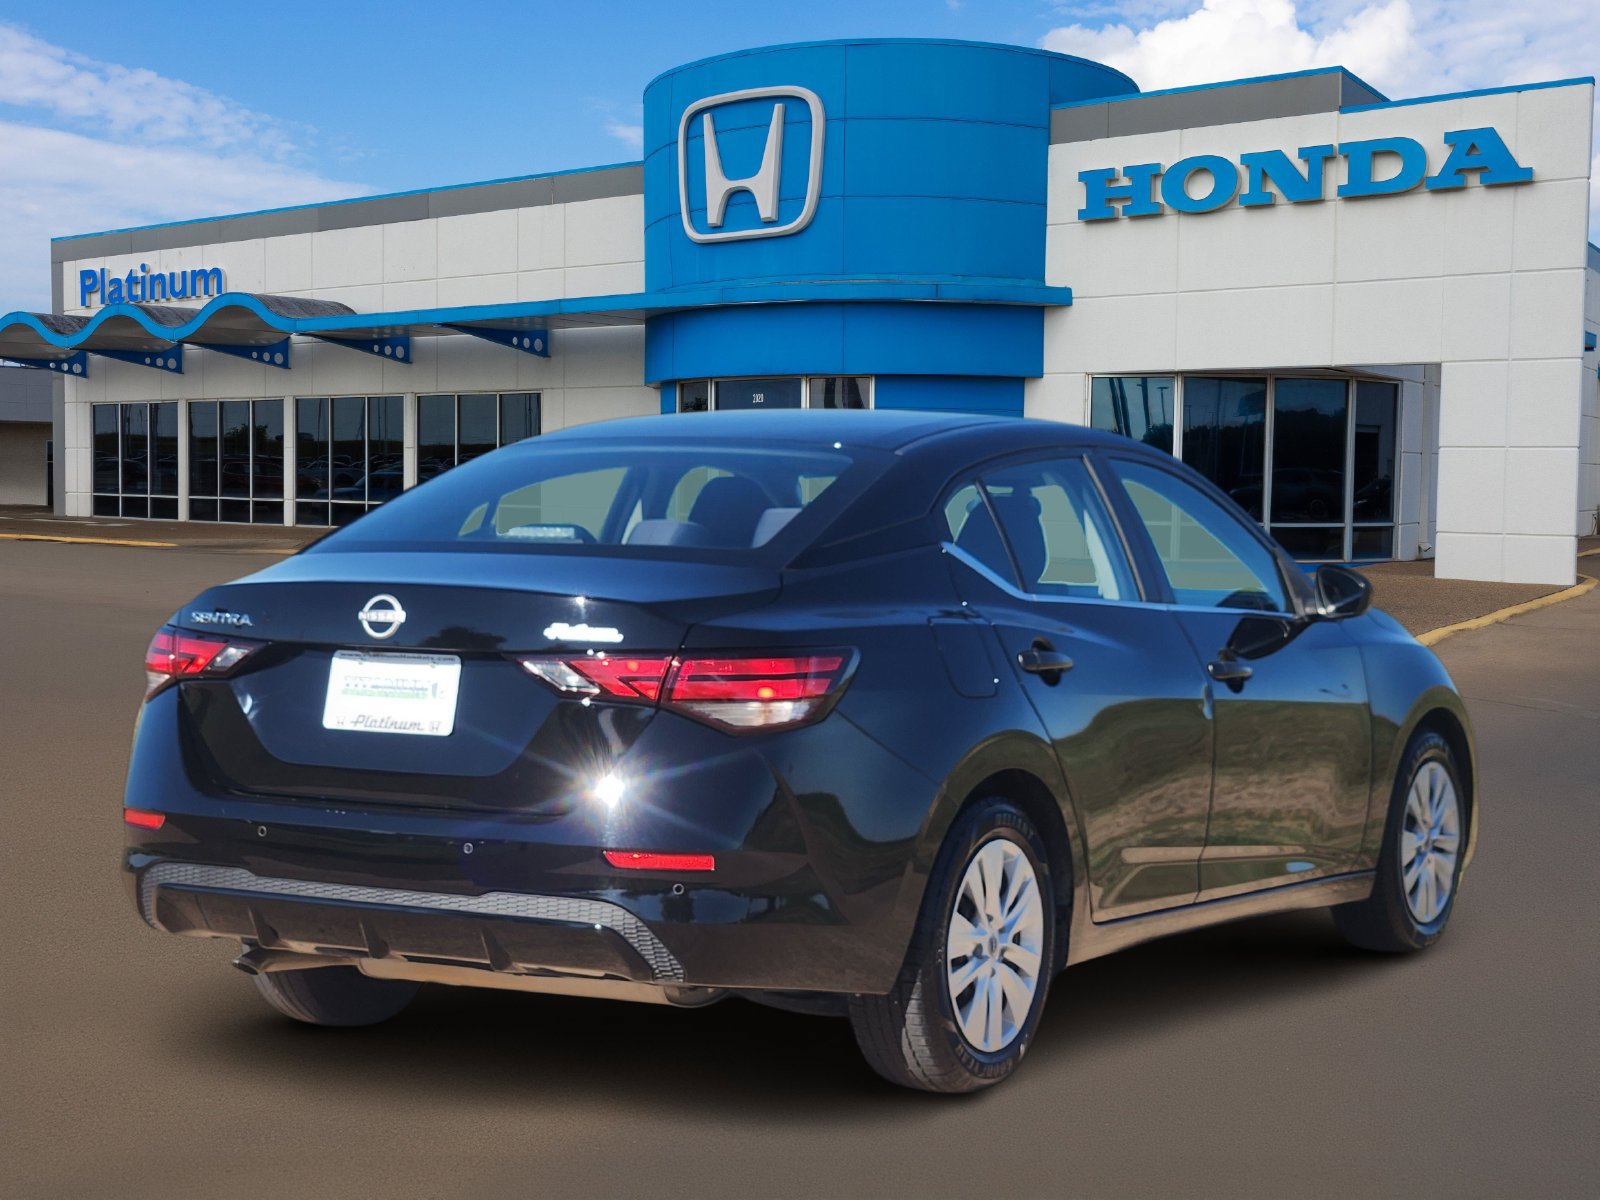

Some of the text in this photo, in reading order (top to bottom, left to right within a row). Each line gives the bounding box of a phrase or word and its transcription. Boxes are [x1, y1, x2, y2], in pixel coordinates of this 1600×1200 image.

[1077, 126, 1534, 220] HONDA
[79, 263, 224, 307] Platinum
[191, 611, 254, 626] SENTRA
[358, 609, 406, 624] NISSA
[351, 714, 425, 732] Platinum
